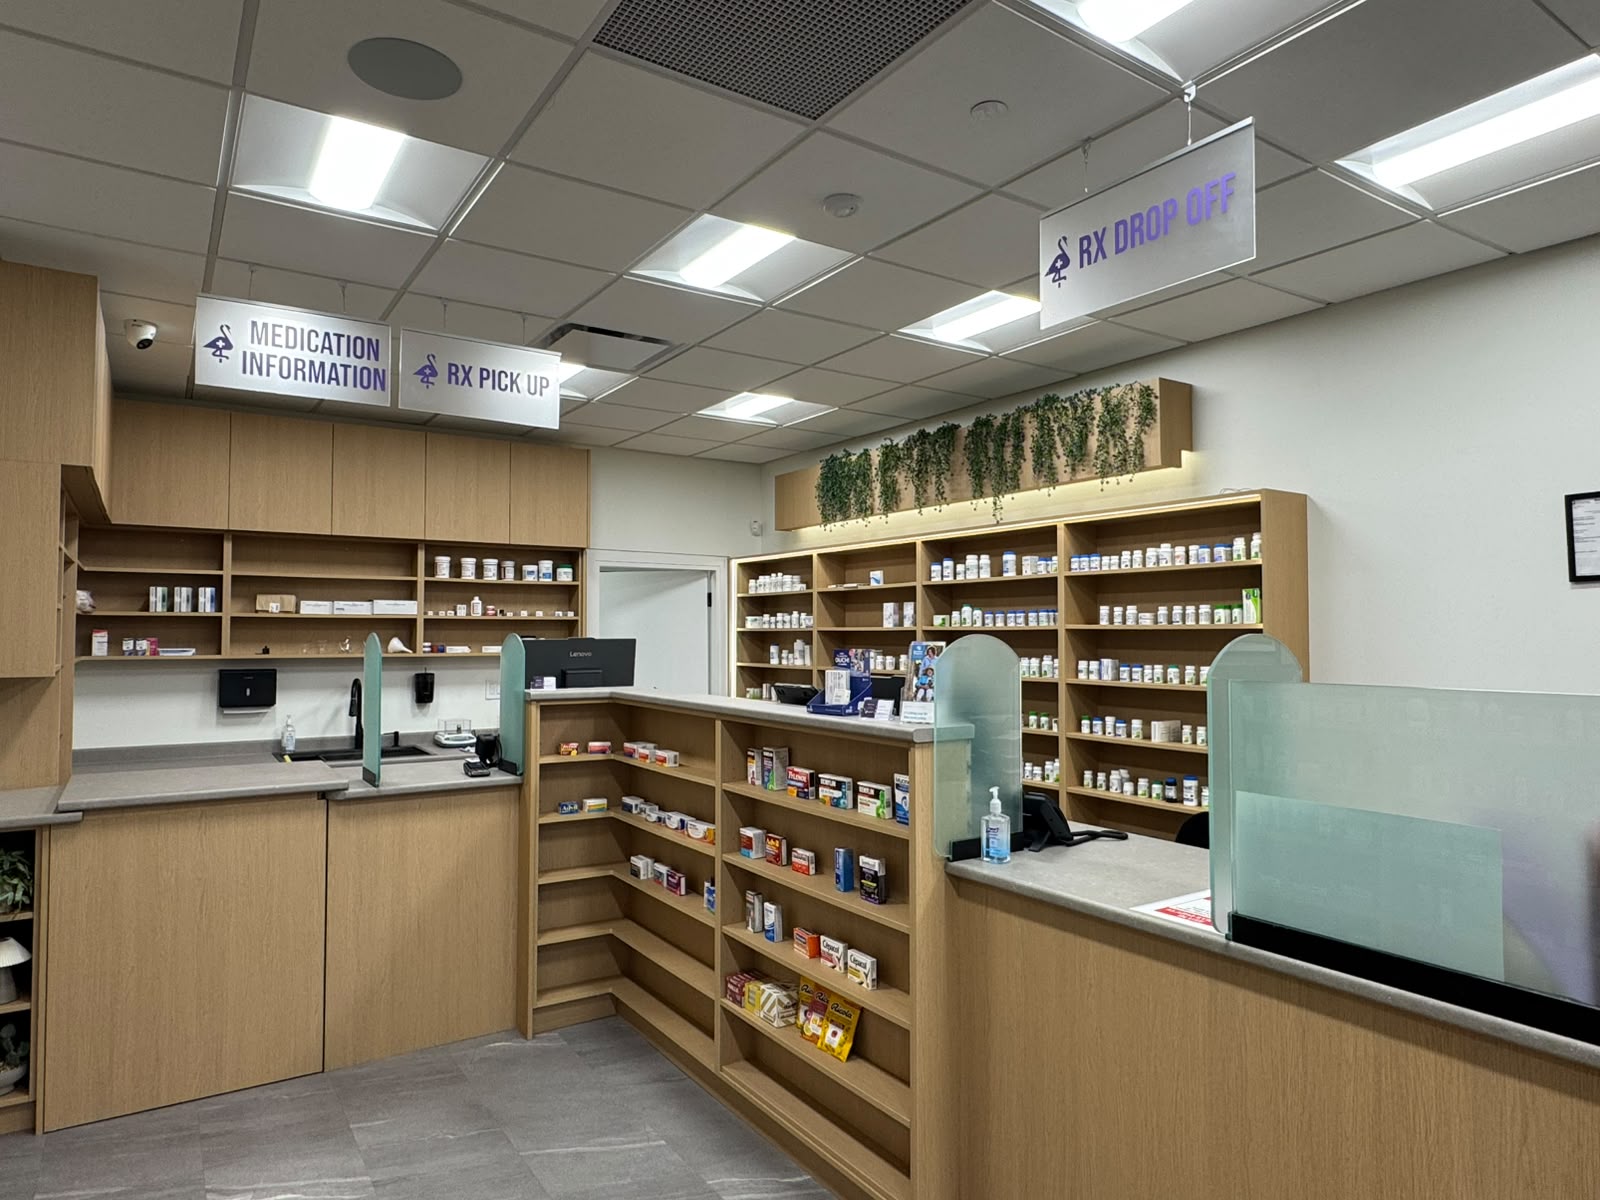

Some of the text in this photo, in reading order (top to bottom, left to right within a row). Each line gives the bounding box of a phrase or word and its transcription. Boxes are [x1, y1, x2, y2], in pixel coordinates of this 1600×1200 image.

[1078, 171, 1236, 269] RX DROP OFF
[250, 320, 380, 362] MEDICATION
[241, 350, 386, 392] INFORMATION
[447, 362, 549, 397] RX PICK UP
[831, 1002, 853, 1019] Ricola
